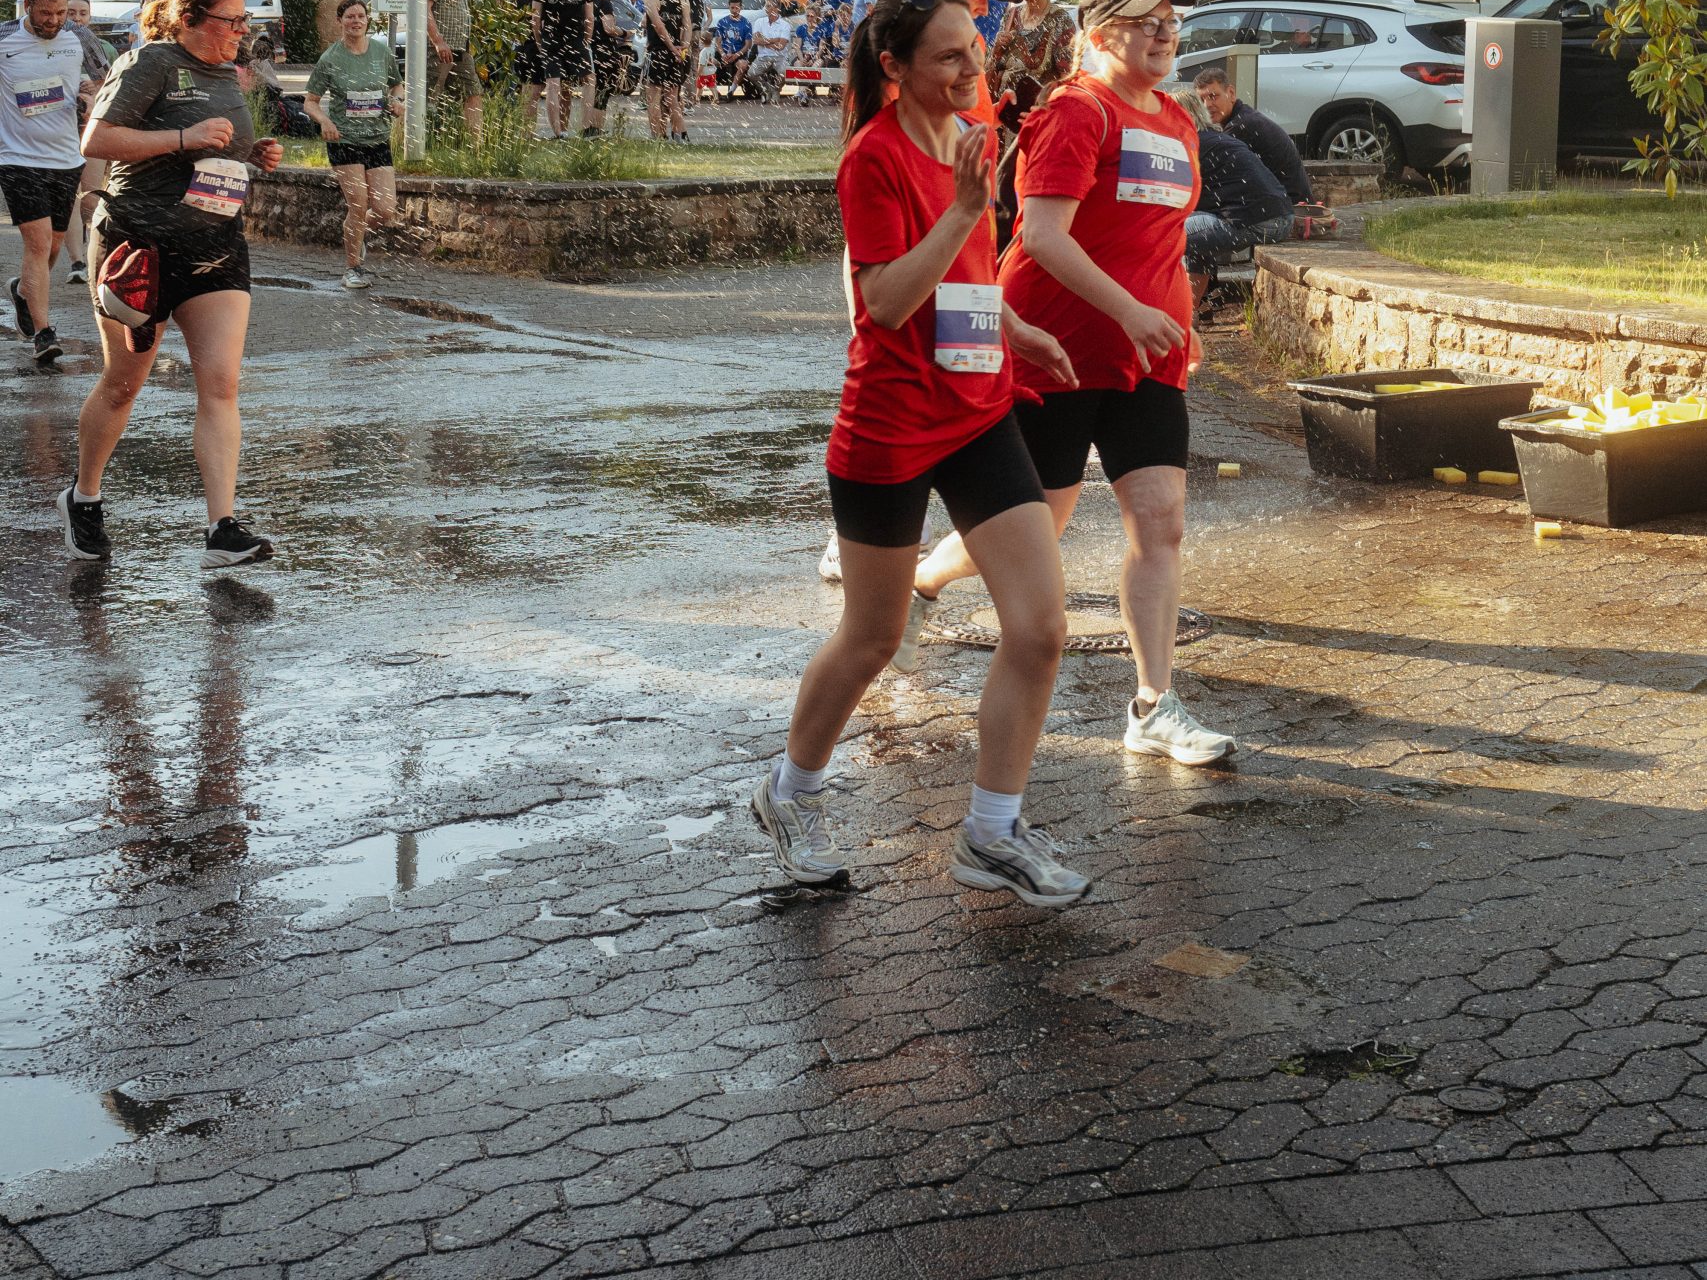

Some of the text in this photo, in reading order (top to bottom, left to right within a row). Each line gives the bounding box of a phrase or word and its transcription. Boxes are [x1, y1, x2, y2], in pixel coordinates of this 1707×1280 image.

[30, 89, 50, 99] 7003
[1149, 154, 1175, 173] 7012
[195, 172, 247, 192] Anna-Maria
[968, 312, 1000, 331] 7013
